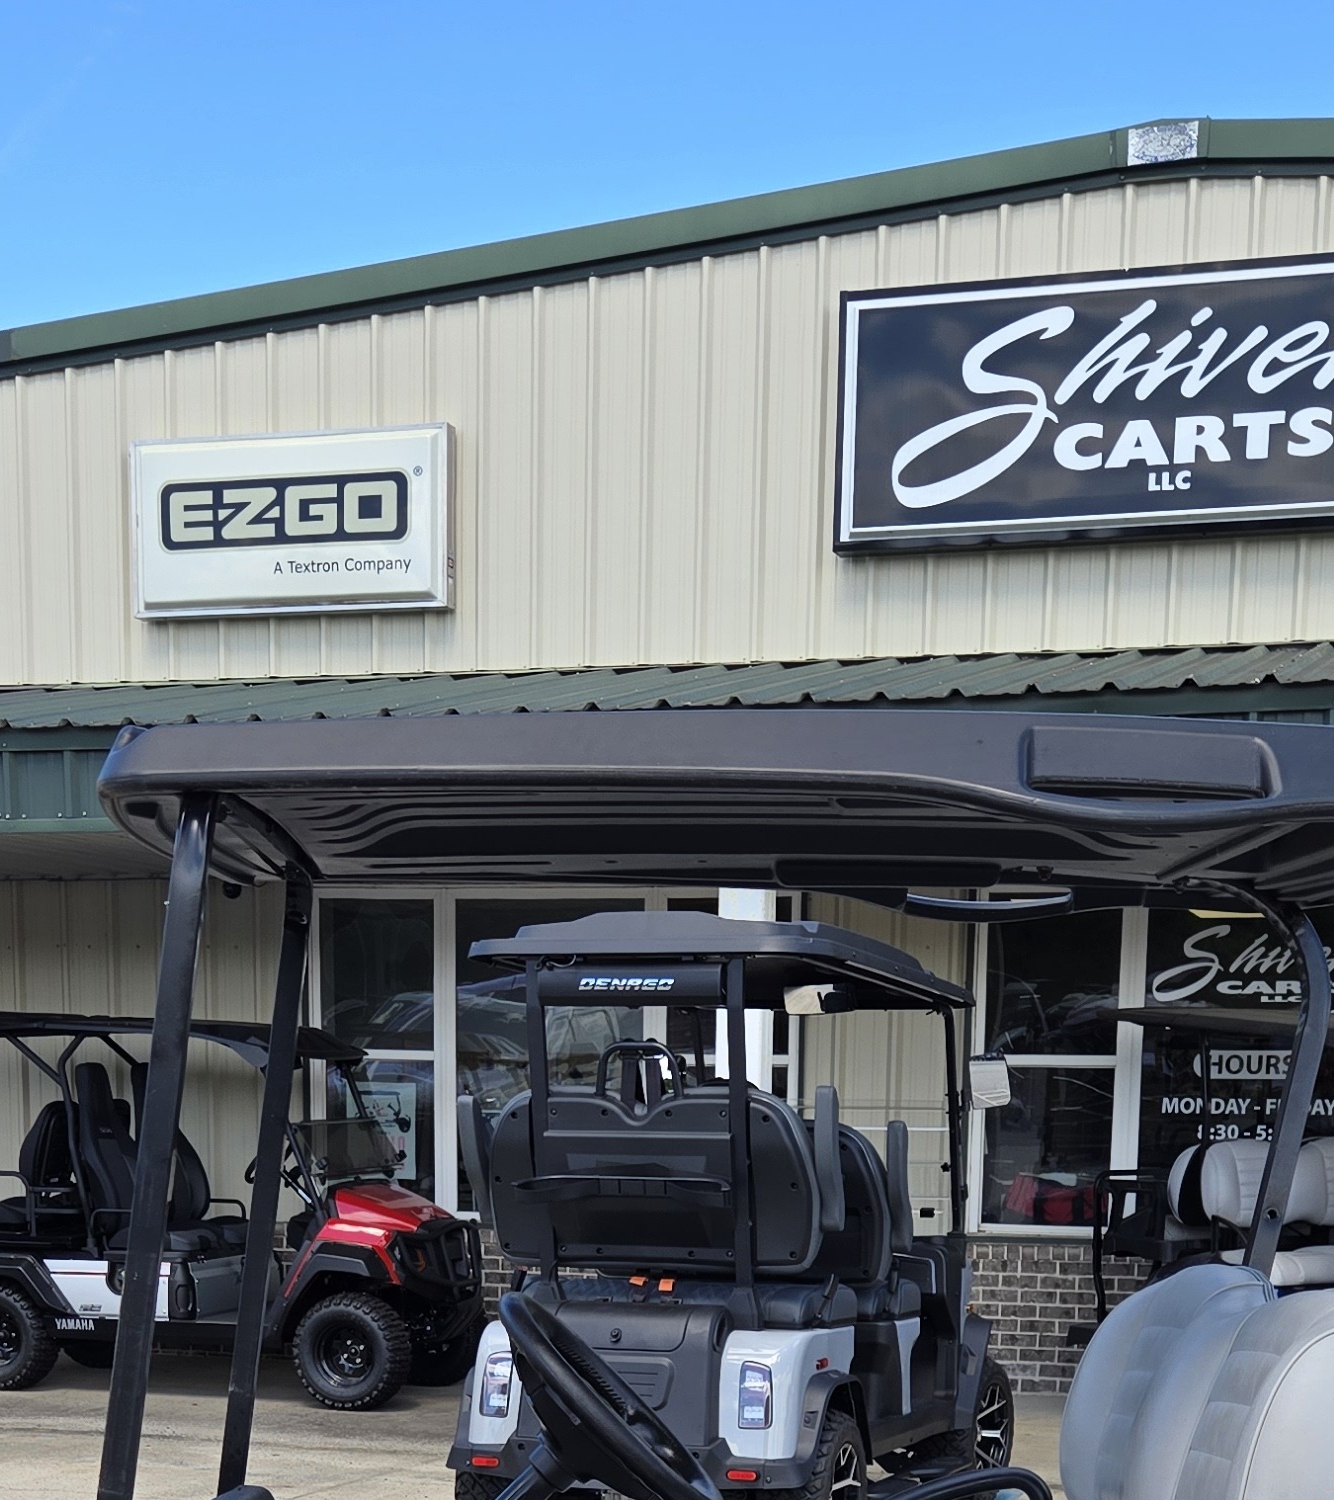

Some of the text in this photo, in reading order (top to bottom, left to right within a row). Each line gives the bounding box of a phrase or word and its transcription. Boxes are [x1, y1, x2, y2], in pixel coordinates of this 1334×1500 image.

[1054, 407, 1334, 470] CARTS
[1147, 470, 1191, 493] LLC
[273, 555, 411, 578] A Textron Company
[54, 1318, 95, 1331] YAMAHA
